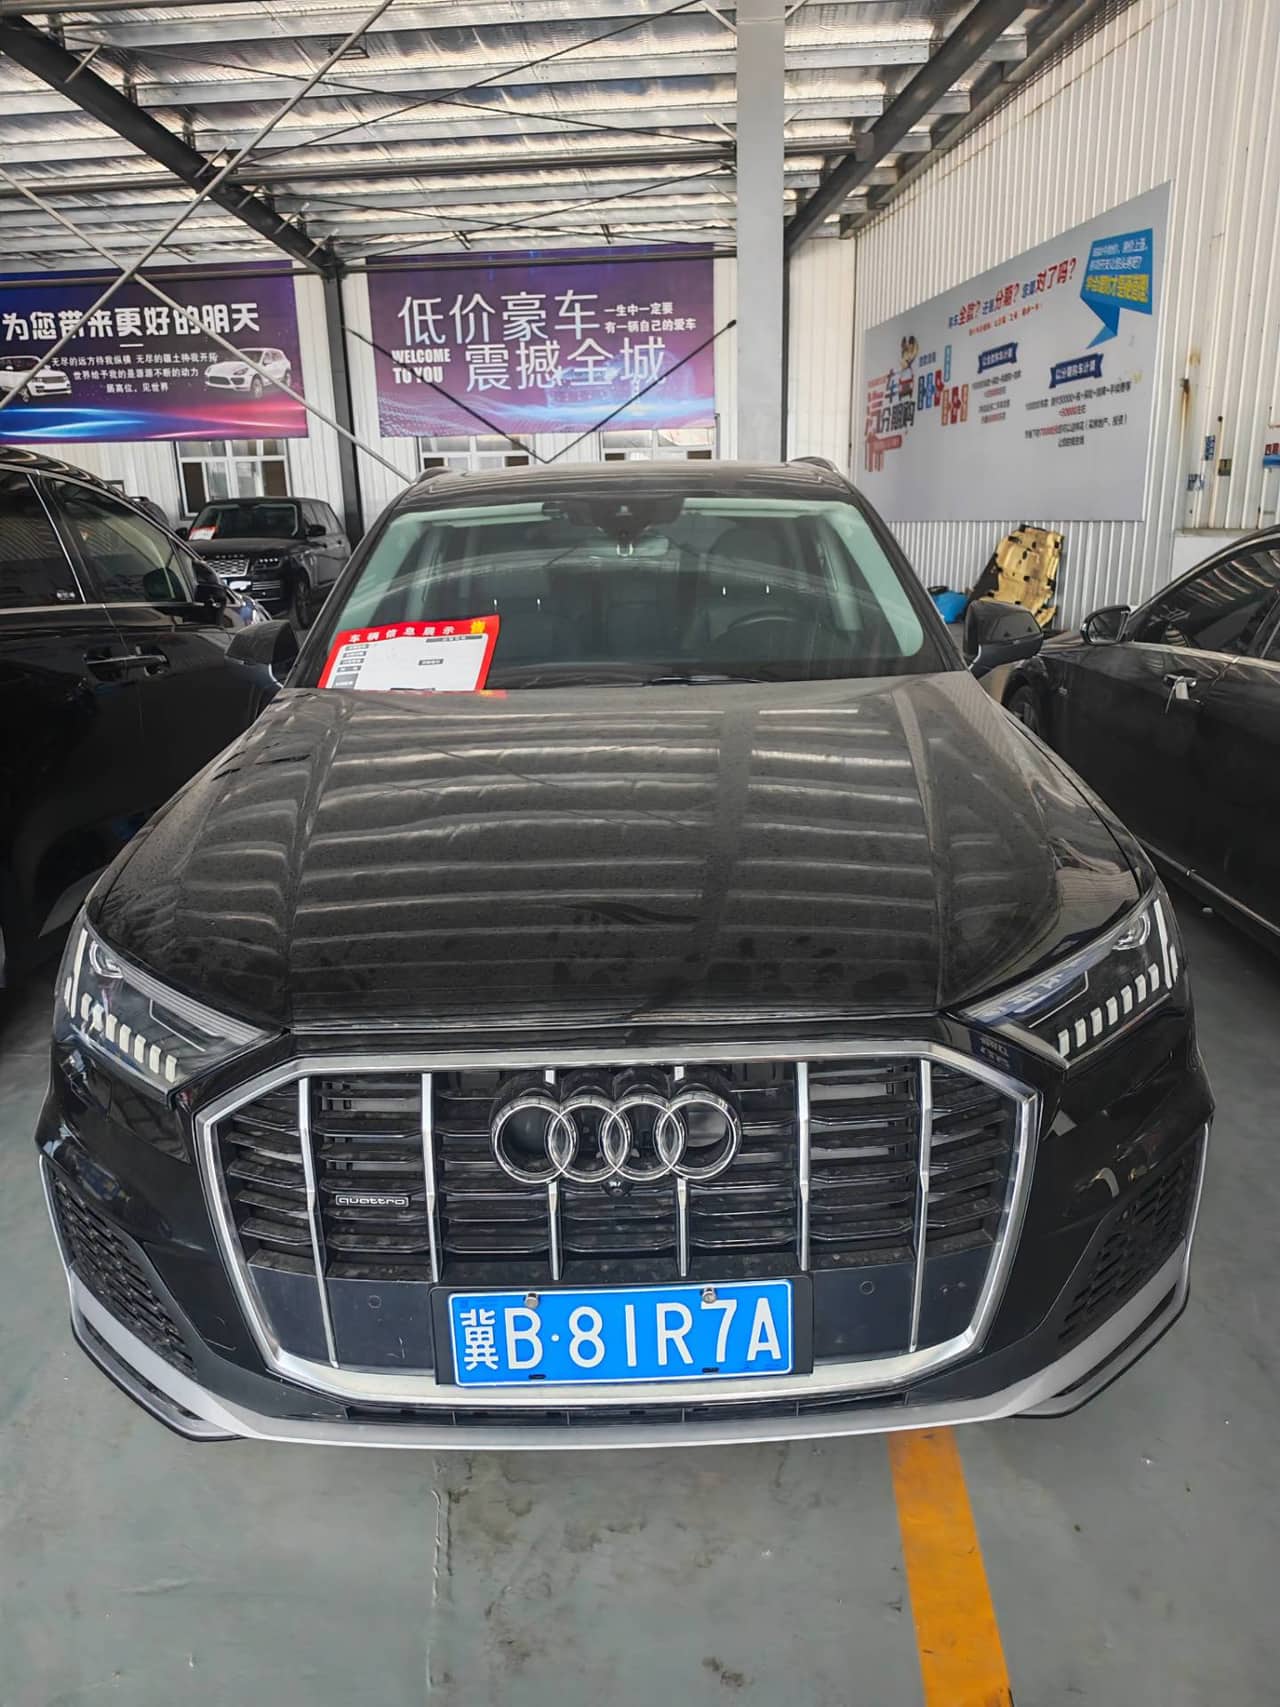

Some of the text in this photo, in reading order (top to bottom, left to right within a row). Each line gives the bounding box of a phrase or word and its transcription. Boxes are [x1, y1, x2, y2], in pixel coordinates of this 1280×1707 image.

[398, 289, 601, 346] 低价豪车
[603, 301, 674, 317] 一生中一定要
[2, 302, 260, 341] 为您带来更好的明天
[604, 318, 697, 334] 有一辆自己的爱车
[392, 348, 451, 364] WELCOME
[465, 336, 667, 392] 震撼全城
[393, 366, 443, 384] TO YOU
[338, 1196, 406, 1206] quattro
